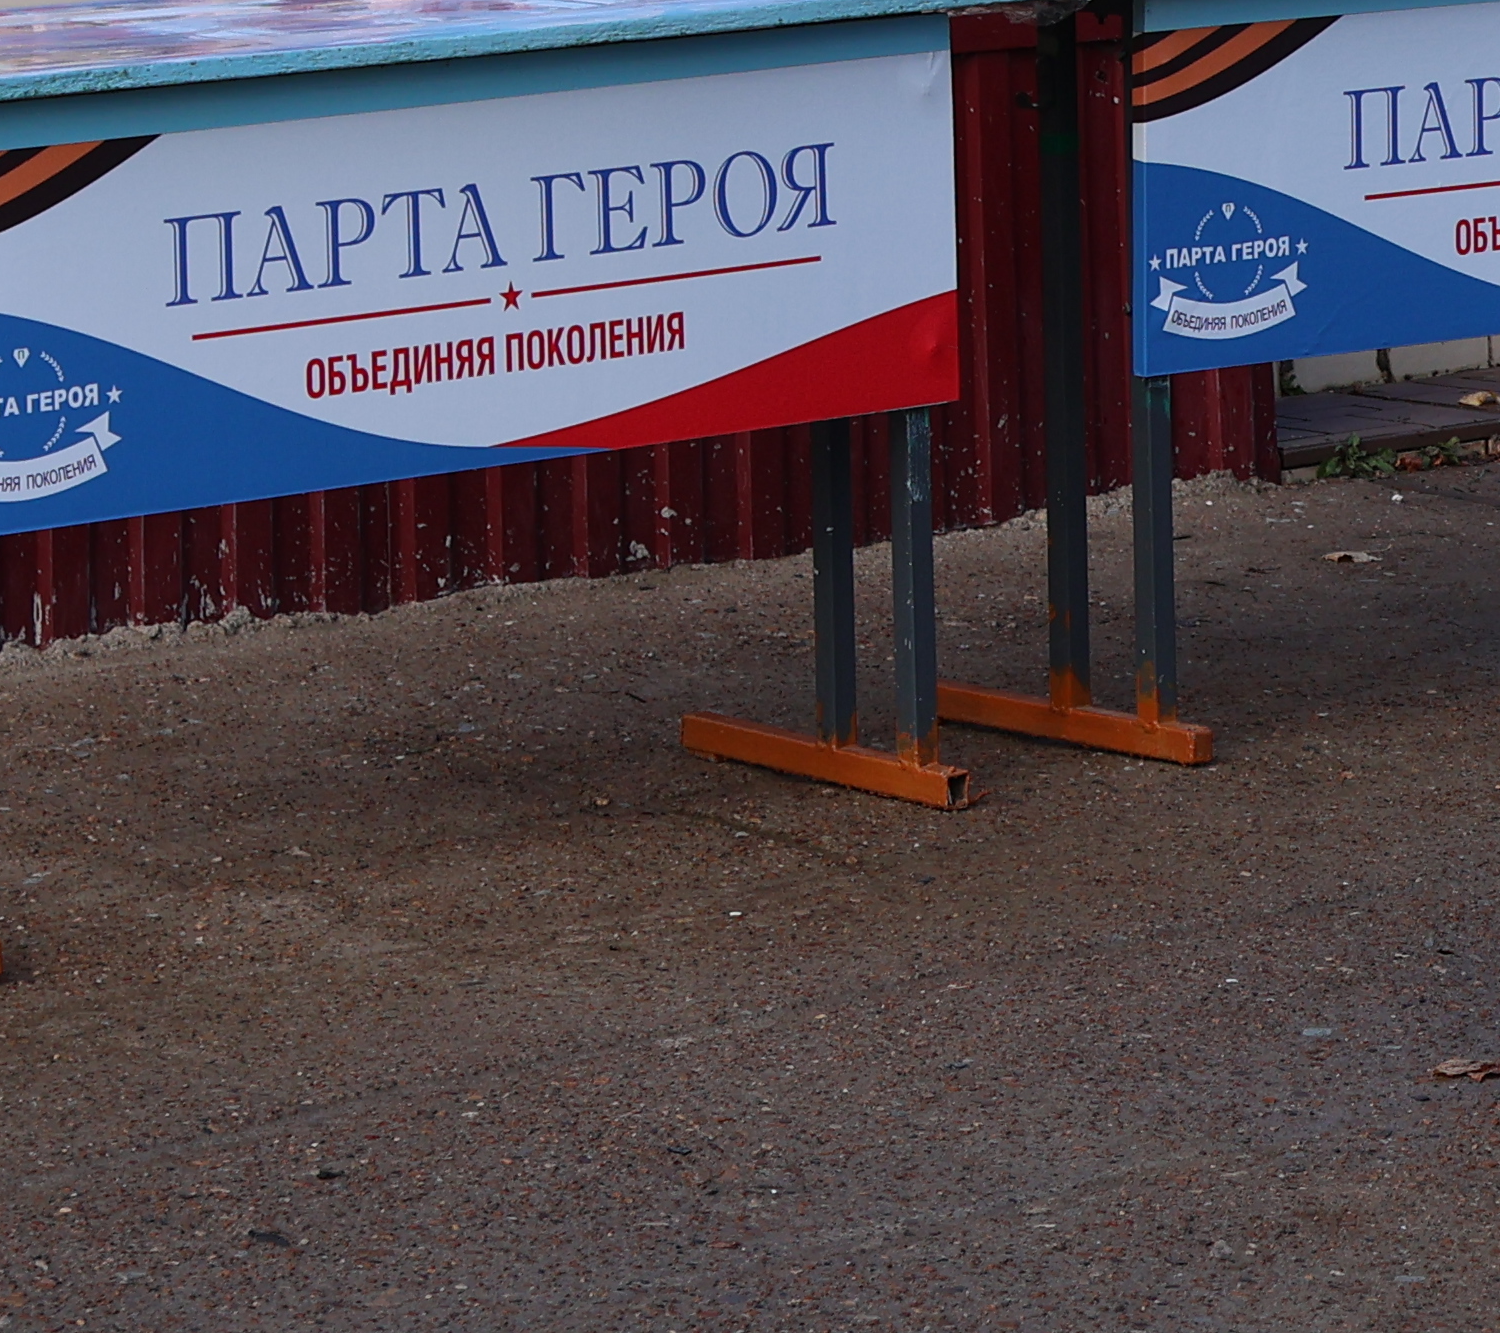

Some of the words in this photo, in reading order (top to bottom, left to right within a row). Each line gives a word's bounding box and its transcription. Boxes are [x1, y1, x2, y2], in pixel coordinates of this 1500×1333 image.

[164, 182, 507, 308] ПАРТА
[529, 141, 836, 263] ГЕРОЯ
[1165, 245, 1226, 270] ПАРТА
[1231, 235, 1290, 262] ГЕРОЯ
[1171, 309, 1227, 332] ОБЪЕДИНЯЯ
[1230, 299, 1288, 329] ПОКОЛЕНИЯ
[305, 336, 495, 400] ОБЪЕДИНЯЯ
[504, 311, 686, 373] ПОКОЛЕНИЯ
[26, 383, 99, 414] ГЕРОЯ
[26, 453, 98, 489] ПОКОЛЕНИЯ
